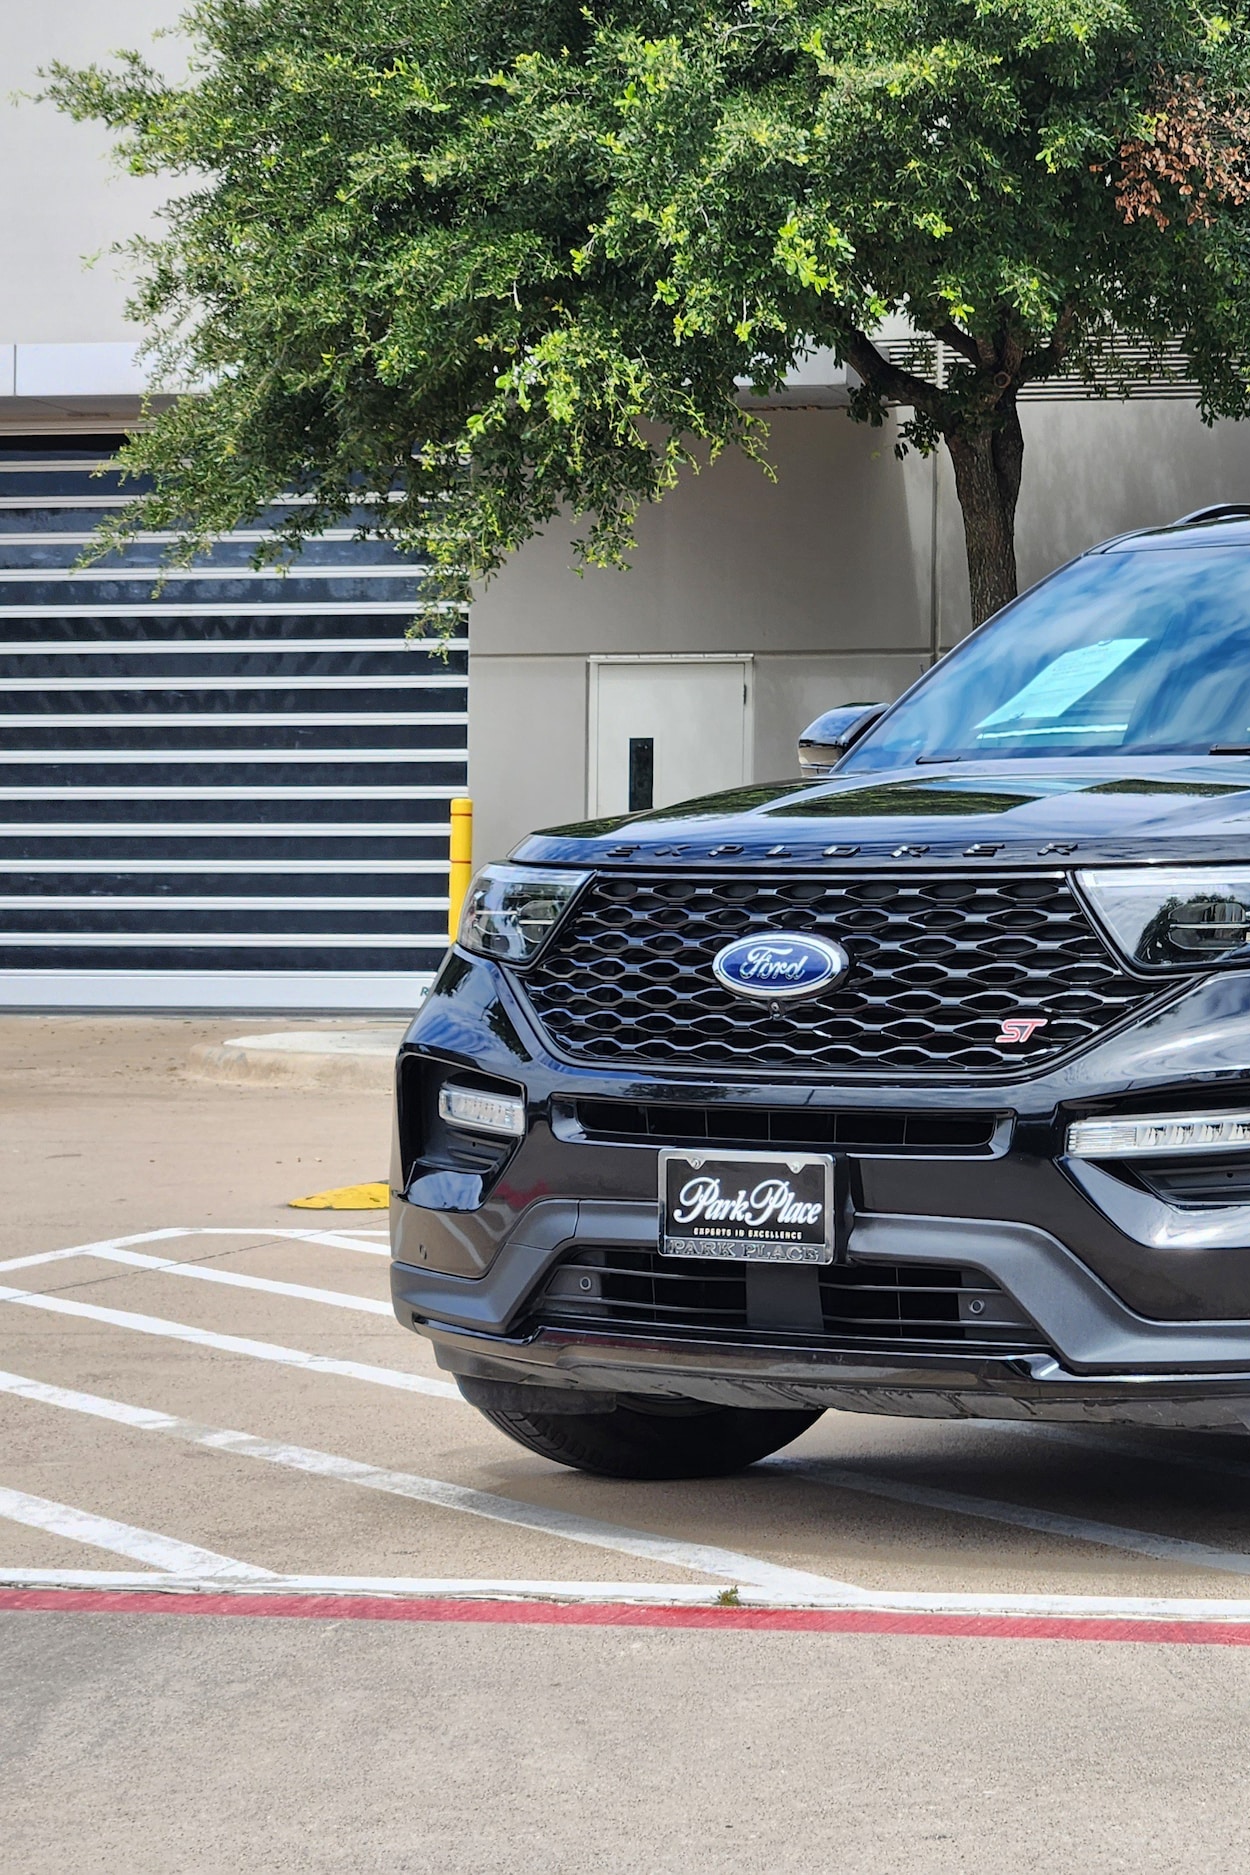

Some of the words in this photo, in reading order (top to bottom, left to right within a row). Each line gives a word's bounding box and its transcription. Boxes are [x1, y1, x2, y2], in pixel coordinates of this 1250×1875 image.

[606, 842, 1079, 858] EXPLORER
[739, 946, 809, 980] Ford
[994, 1017, 1049, 1043] ST
[673, 1176, 750, 1224] Park
[744, 1179, 823, 1226] Place
[693, 1227, 732, 1237] EXPERTS
[734, 1229, 746, 1238] IN
[747, 1229, 803, 1241] EXCELLENCE
[669, 1239, 737, 1258] PARK
[740, 1243, 819, 1262] PLACE
